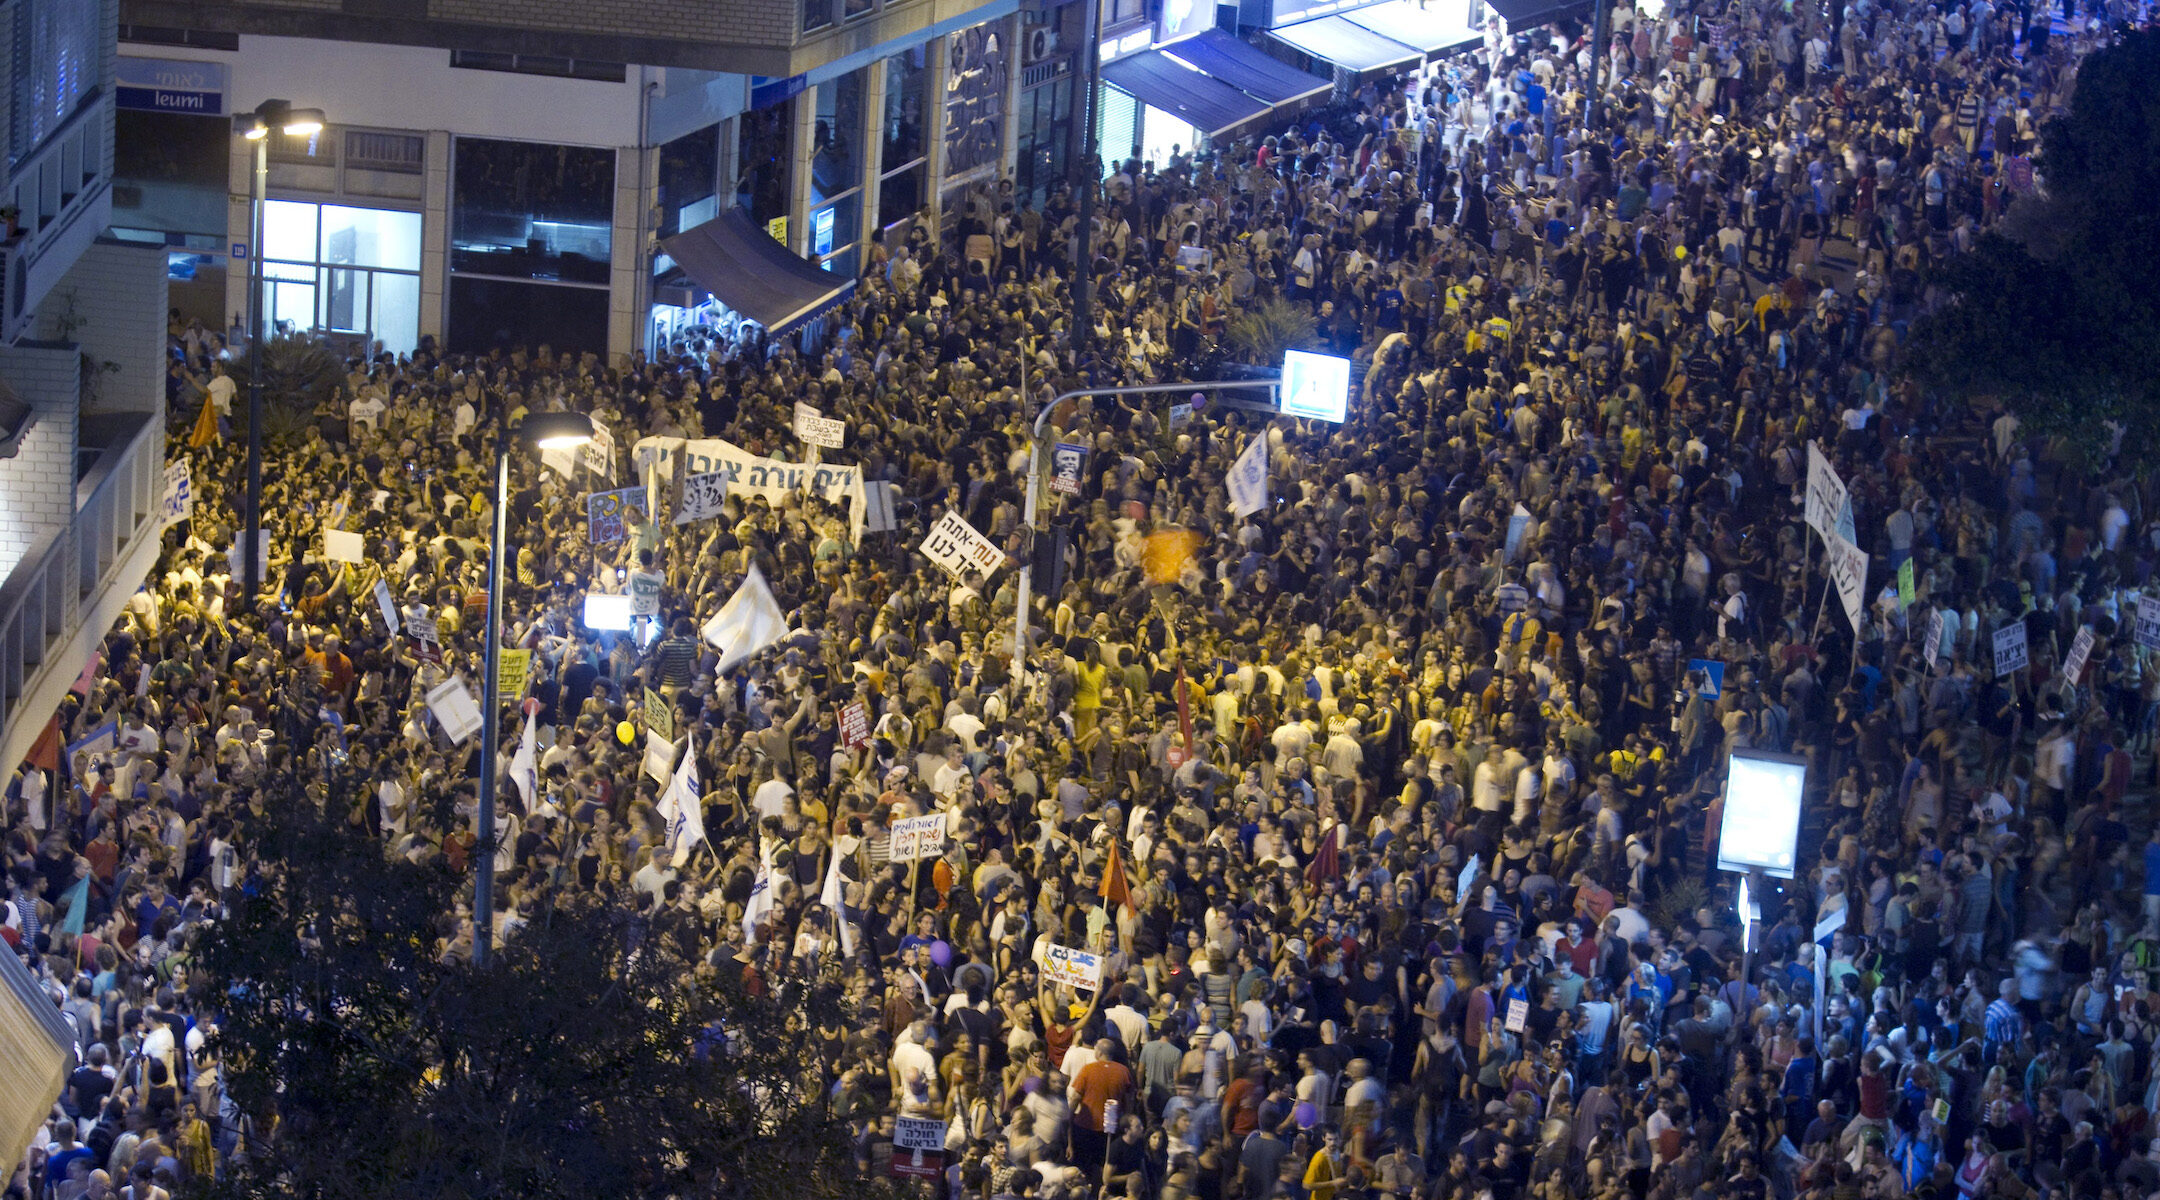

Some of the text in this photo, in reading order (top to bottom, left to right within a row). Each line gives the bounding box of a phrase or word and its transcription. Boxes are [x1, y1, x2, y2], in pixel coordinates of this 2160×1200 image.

[156, 71, 204, 88] לאומי
[155, 90, 203, 108] leumi
[930, 535, 956, 558] לנו
[898, 1119, 943, 1129] המדינה
[905, 1128, 936, 1139] חולה
[902, 1138, 938, 1148] בראש
